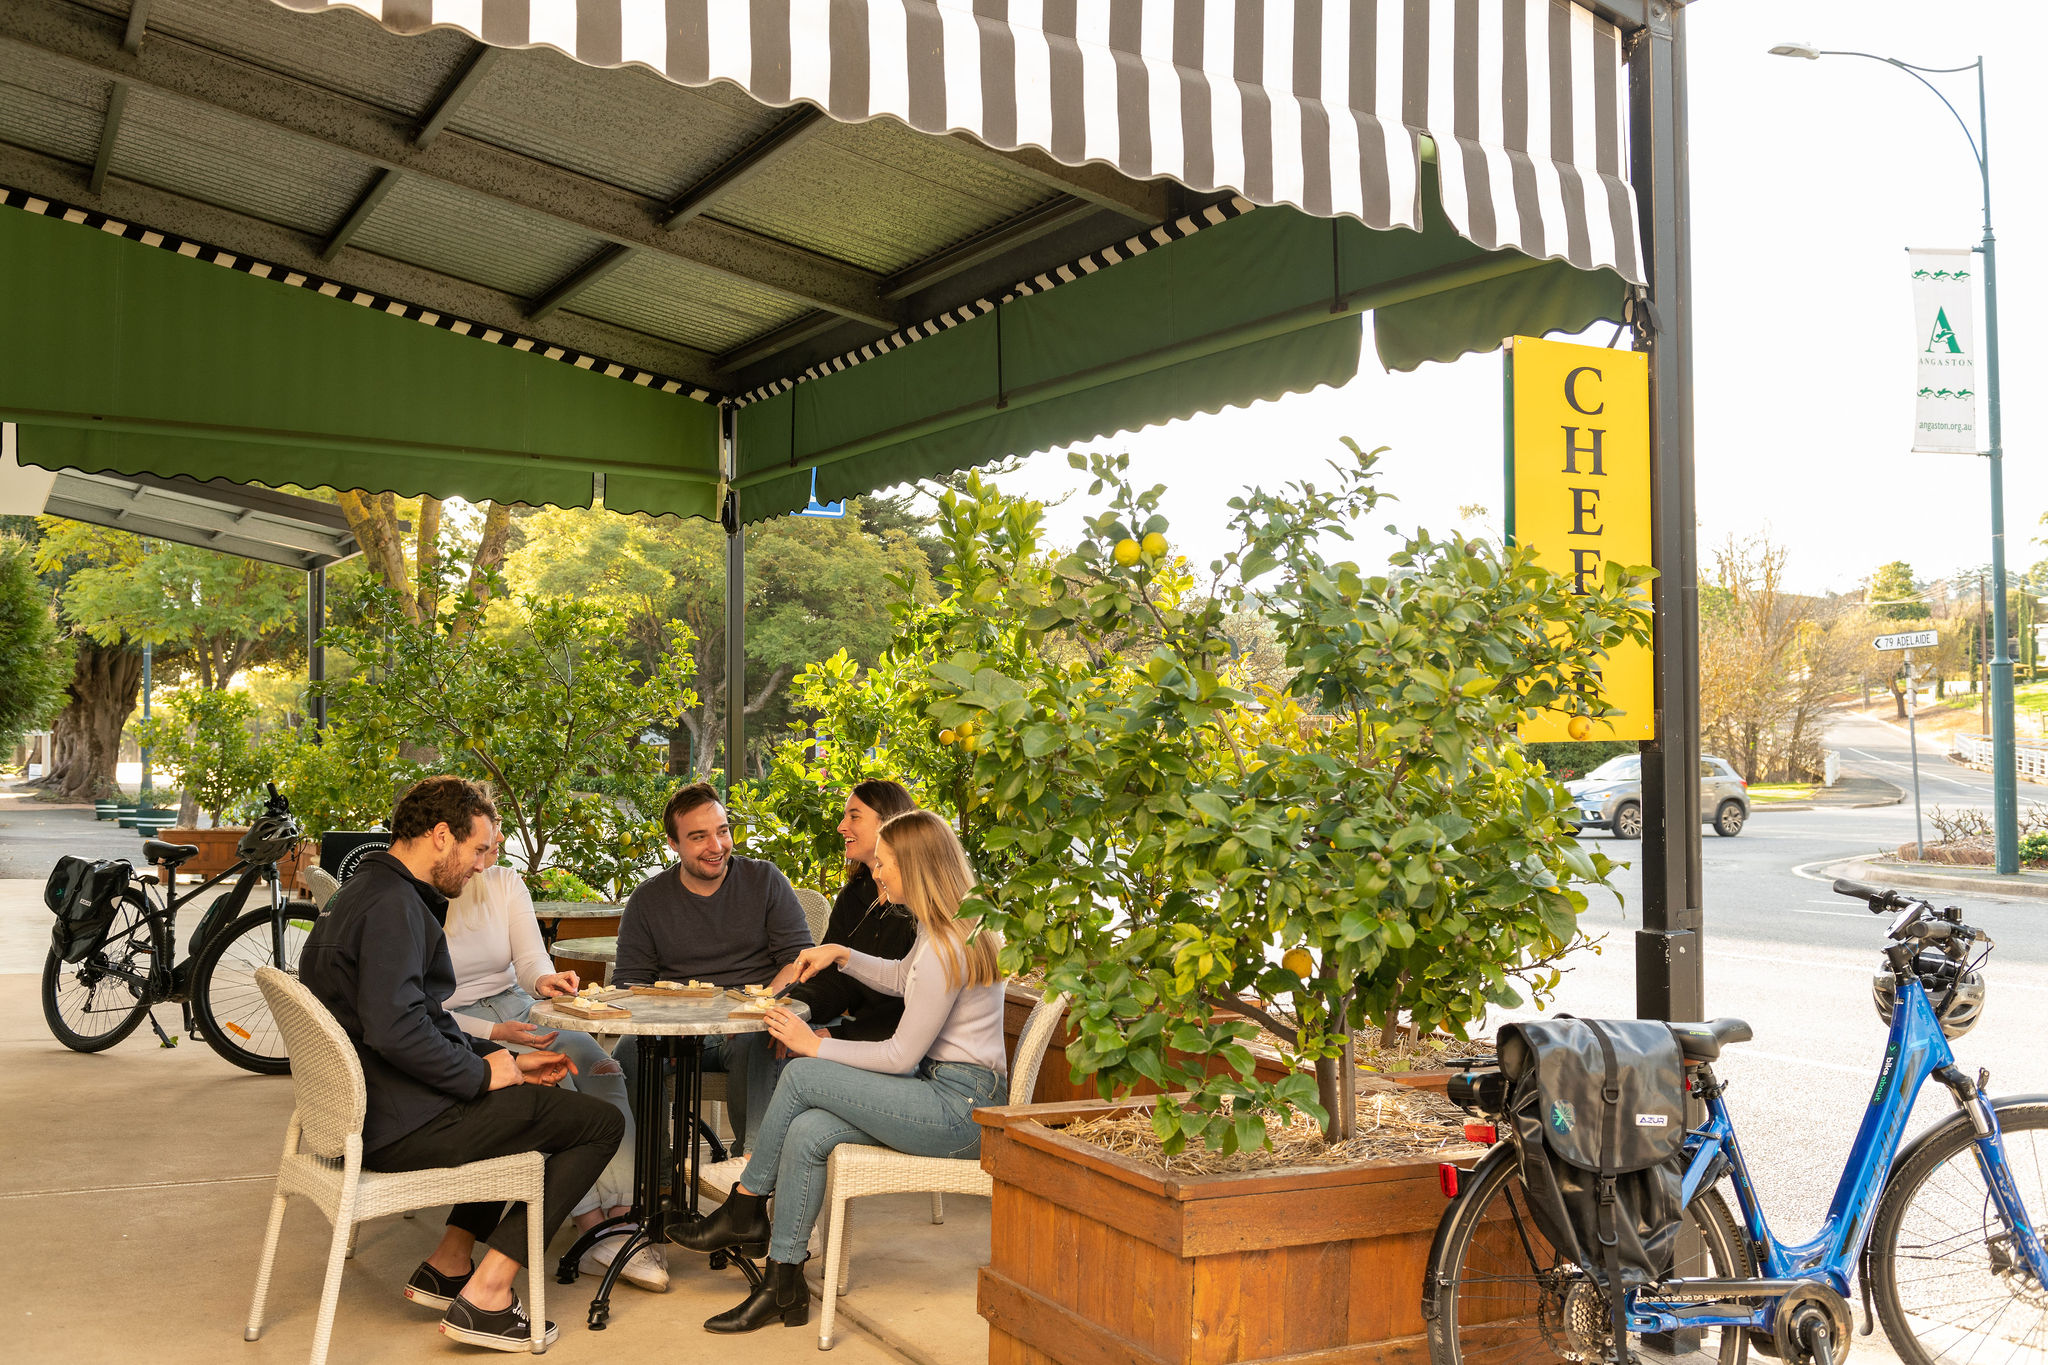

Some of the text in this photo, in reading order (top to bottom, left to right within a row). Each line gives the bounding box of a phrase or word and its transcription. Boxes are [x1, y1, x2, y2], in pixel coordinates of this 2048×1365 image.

[1918, 357, 1973, 367] ANGASTON
[1918, 421, 1973, 433] angaston.org.au
[1884, 633, 1931, 648] 79 ADELAIDE
[1639, 1116, 1665, 1124] AZUR
